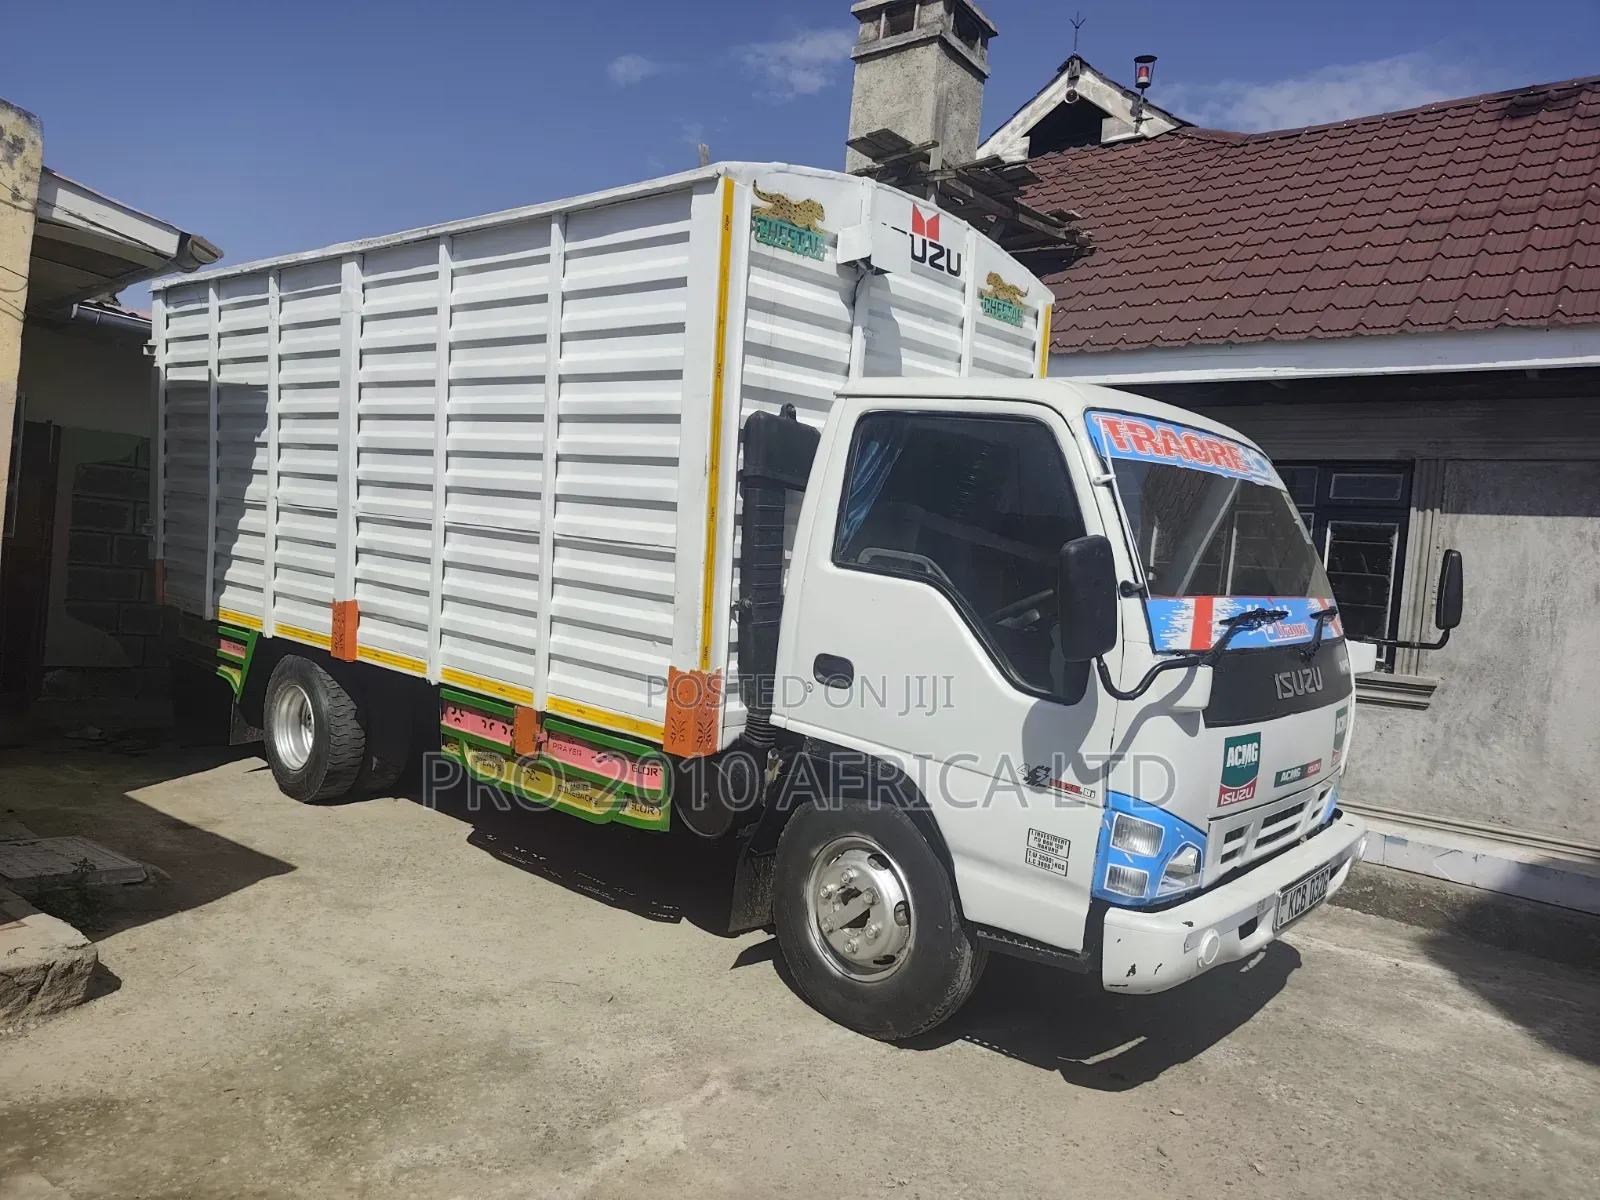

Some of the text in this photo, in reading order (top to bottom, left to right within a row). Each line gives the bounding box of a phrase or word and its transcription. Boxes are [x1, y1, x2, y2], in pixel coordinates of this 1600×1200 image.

[1274, 666, 1323, 699] ISUZU
[552, 742, 582, 757] PRAYER
[1226, 742, 1258, 767] ACMG
[1280, 767, 1302, 782] ACMG
[557, 784, 599, 806] COMEBACKS
[1220, 786, 1254, 806] ISUZU
[1288, 884, 1307, 920] KCB
